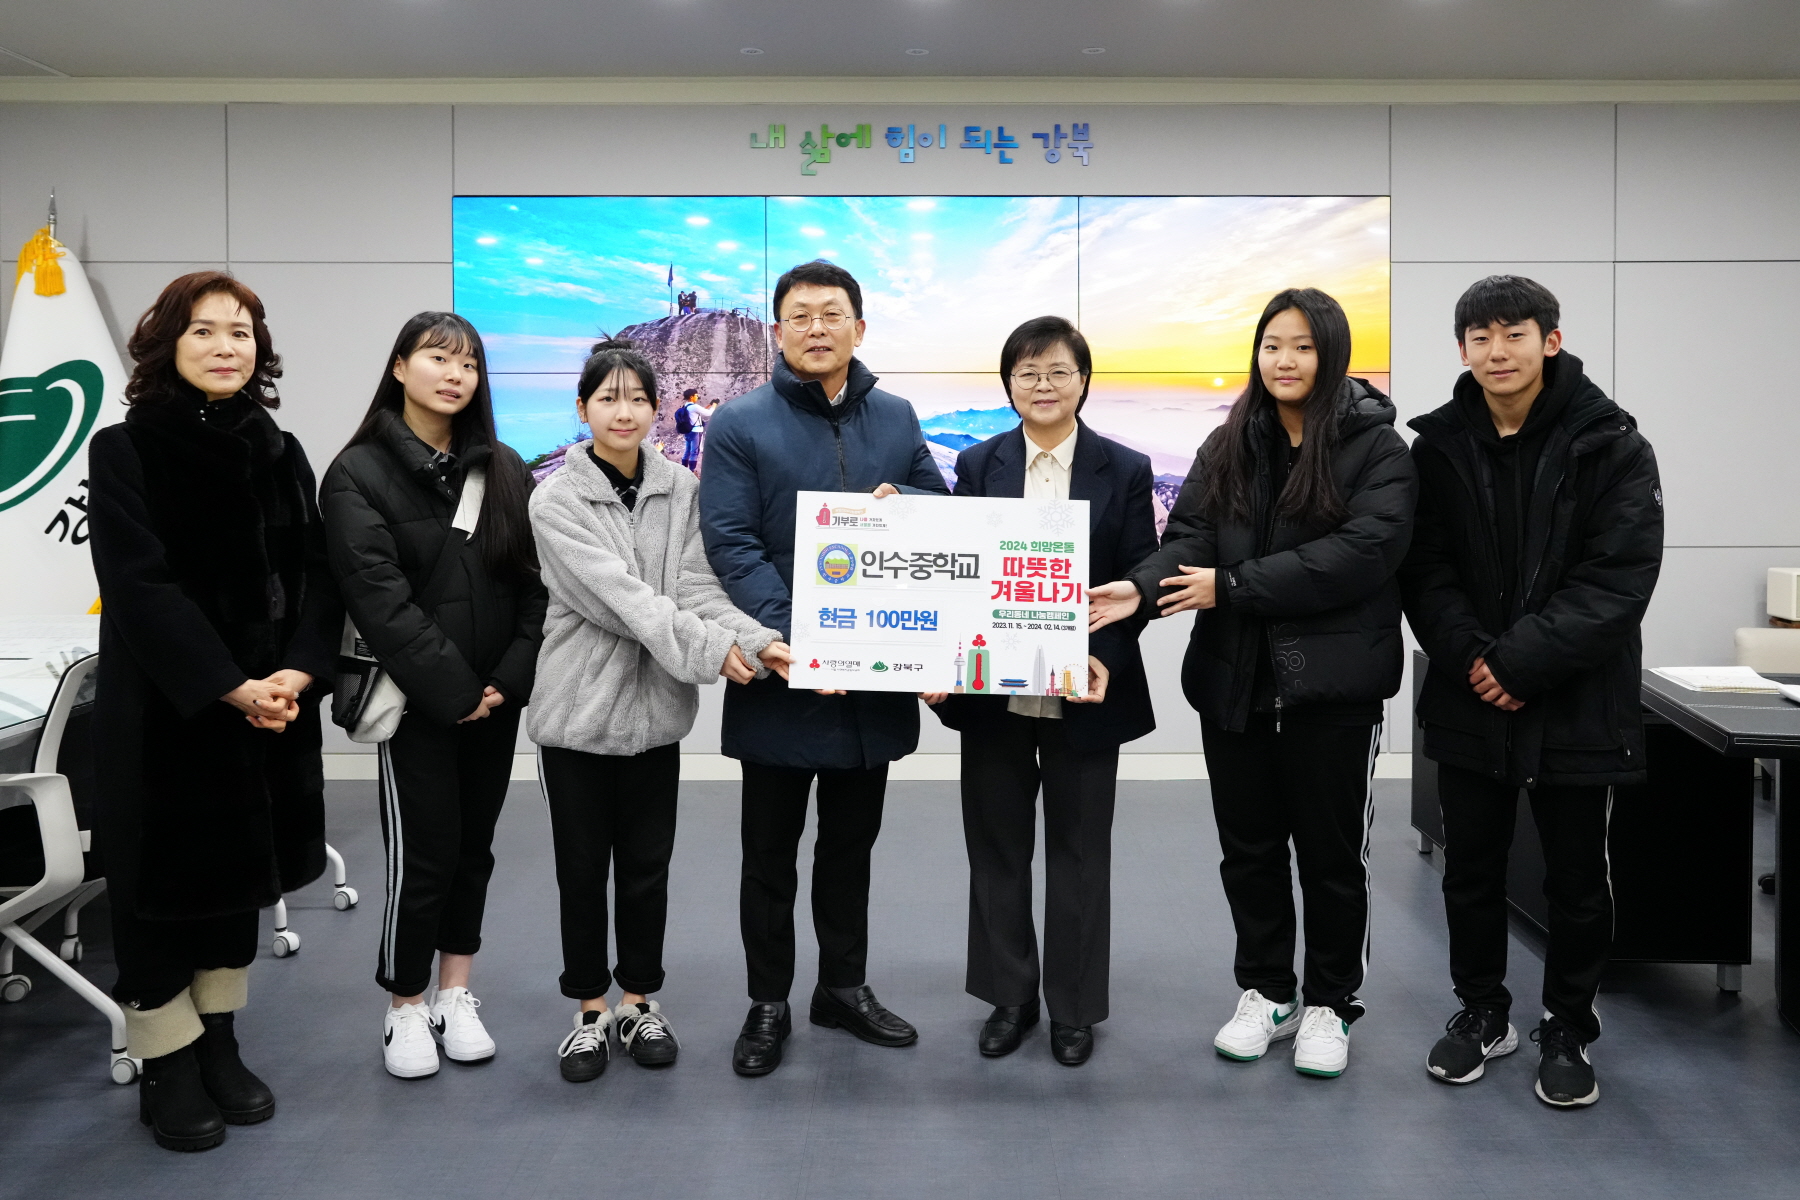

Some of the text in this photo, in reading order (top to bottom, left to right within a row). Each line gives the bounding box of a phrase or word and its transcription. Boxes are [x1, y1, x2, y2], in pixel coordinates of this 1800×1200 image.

[750, 123, 1093, 176] 내 삶에 힘이 되는 강북
[832, 516, 858, 526] 기부로
[1000, 541, 1075, 553] 2024 희망온돌
[861, 550, 980, 580] 인수중학교
[1003, 556, 1072, 579] 따뜻한
[991, 580, 1082, 604] 겨울나기
[818, 607, 938, 631] 현금 100만원
[998, 610, 1030, 619] 우리동네
[893, 663, 923, 672] 강북구
